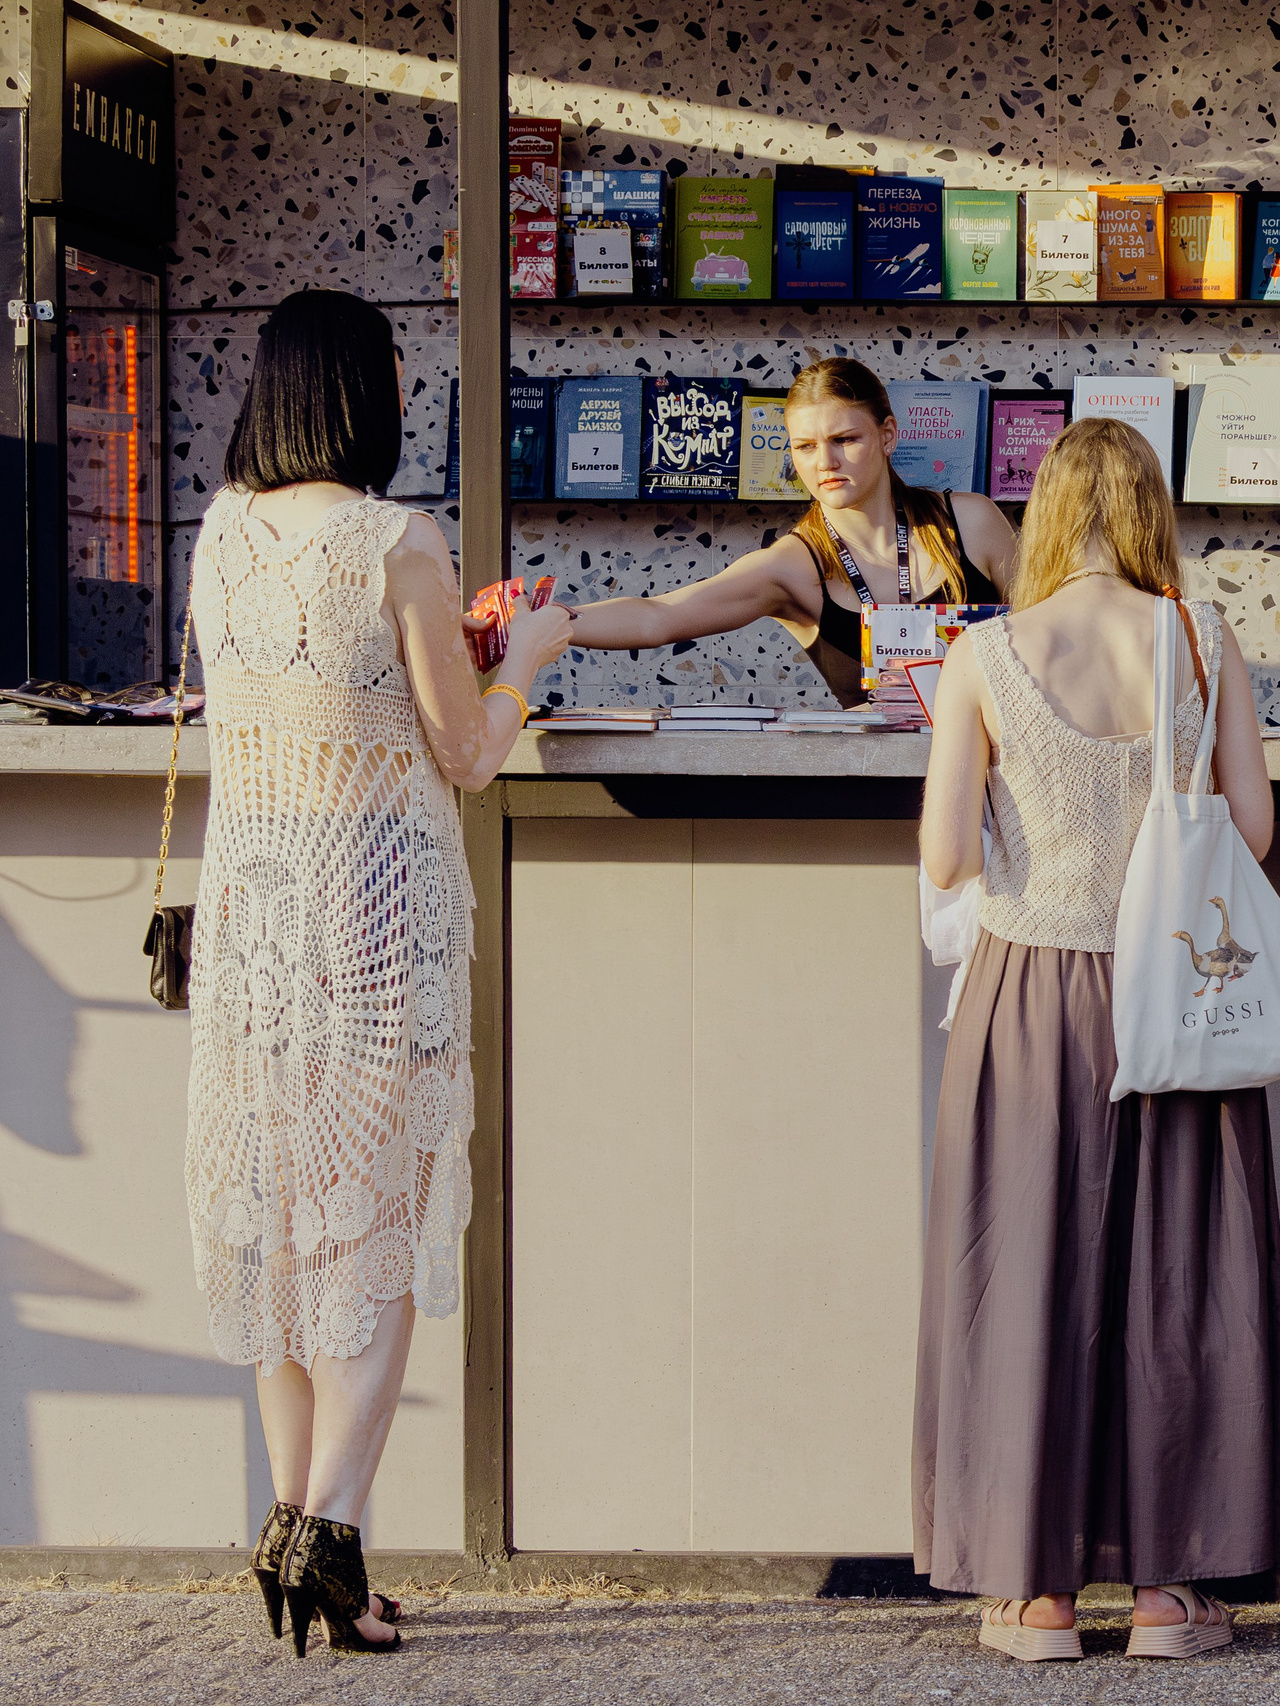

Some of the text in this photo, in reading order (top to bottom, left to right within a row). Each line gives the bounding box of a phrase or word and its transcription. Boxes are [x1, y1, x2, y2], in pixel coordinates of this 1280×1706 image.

[73, 82, 157, 165] EMBARGO
[613, 190, 660, 200] ШАШКИ
[867, 188, 922, 200] ПЕРЕЕЗД
[878, 202, 938, 213] В НОВУЮ
[1098, 209, 1141, 221] МНОГО
[784, 218, 847, 236] САПФИРОВЫЙ
[868, 216, 921, 229] ЖИЗНЬ
[949, 216, 1012, 231] КОРОНОВАННЫЙ
[1098, 221, 1139, 233] ШУМА
[1170, 215, 1223, 239] ЗОЛОТО
[809, 236, 847, 251] КРЕСТ
[959, 231, 1001, 245] ЧЕРЕП
[1061, 234, 1069, 243] 7
[1108, 235, 1145, 246] ИЗ-ЗА
[1265, 237, 1279, 245] ПО
[599, 246, 607, 256] 8
[1040, 250, 1090, 260] Билетов
[1118, 247, 1145, 258] ТЕБЯ
[1188, 240, 1232, 262] БОГОВ
[579, 261, 630, 271] Билетов
[509, 387, 544, 397] ИРЕНЫ
[511, 399, 544, 409] МОЩИ
[580, 400, 620, 410] ДЕРЖИ
[1088, 394, 1161, 407] ОТПУСТИ
[578, 409, 622, 421] ДРУЗЕЙ
[908, 406, 954, 418] УПАСТЬ,
[577, 421, 622, 432] БЛИЗКО
[751, 423, 788, 433] БУМАЖ
[910, 418, 950, 428] ЧТОБЫ
[1221, 422, 1245, 431] УЙТИ
[1007, 427, 1047, 437] ВСЕГДА
[1005, 437, 1054, 446] ОТЛИЧНА
[592, 447, 600, 456] 7
[998, 446, 1028, 456] ИДЕЯ!
[571, 461, 620, 471] Билетов
[1251, 461, 1259, 470] 7
[1229, 476, 1279, 486] Билетов
[897, 523, 908, 554] 1.EVENT
[838, 549, 860, 578] 1.EVENT
[898, 565, 910, 595] 1.EVENT
[899, 627, 907, 638] 8
[875, 645, 932, 656] Билетов
[1181, 1000, 1265, 1028] GUSSI
